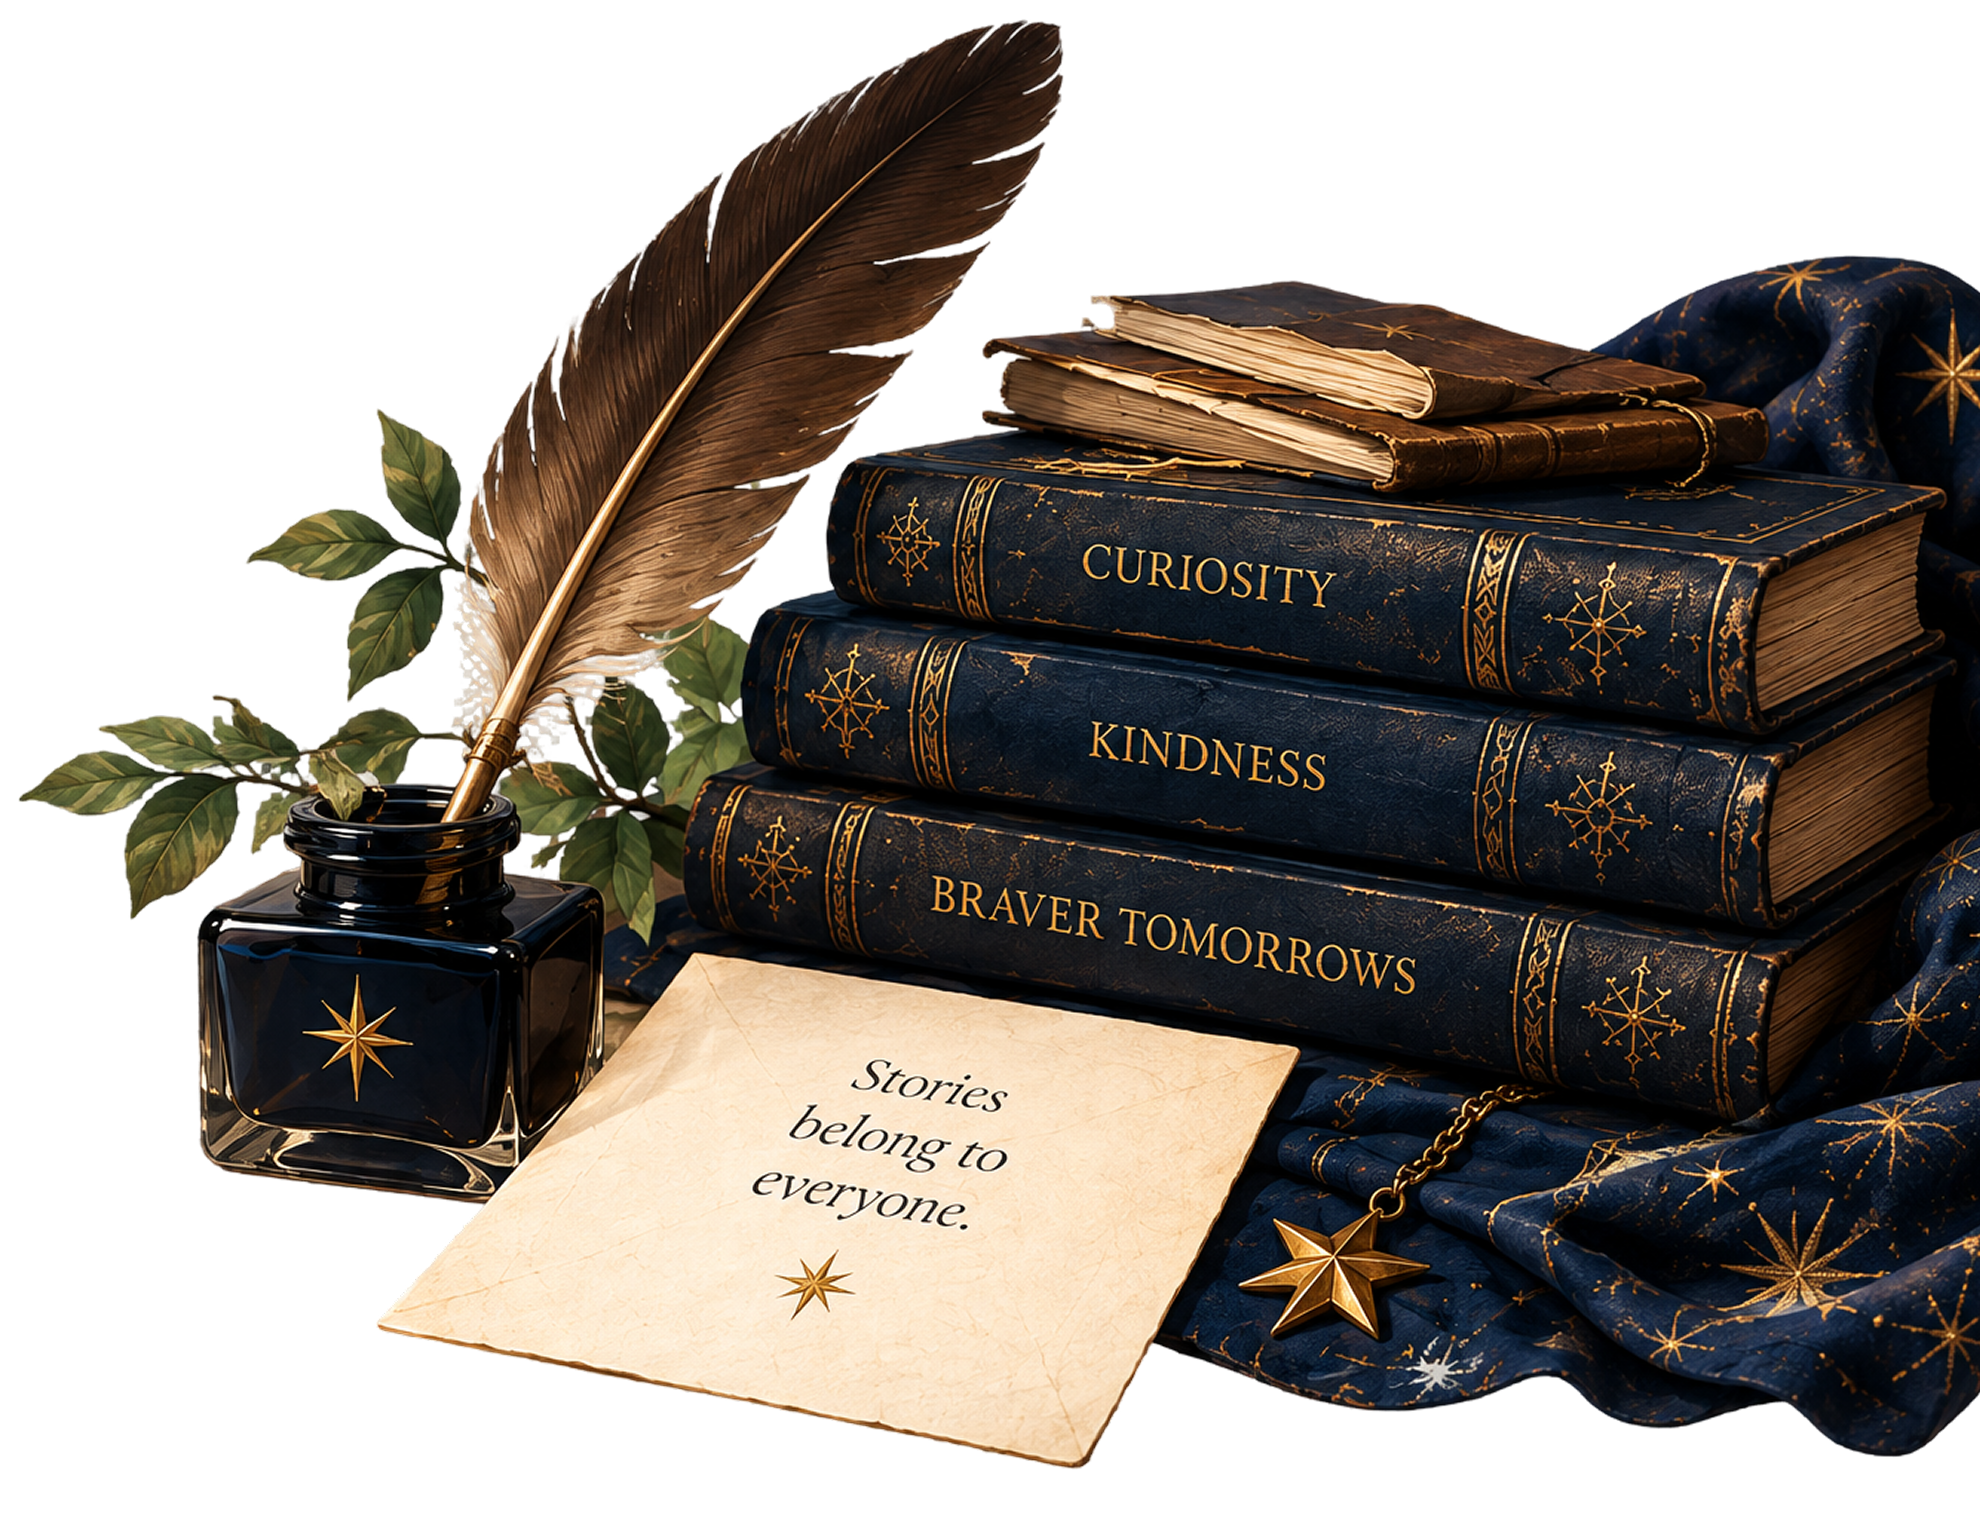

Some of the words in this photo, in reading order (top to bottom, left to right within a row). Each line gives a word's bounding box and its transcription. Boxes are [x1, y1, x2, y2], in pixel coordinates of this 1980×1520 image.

[1082, 543, 1337, 609] CURIOSITY
[1089, 721, 1327, 791] KINDNESS
[930, 875, 1105, 940] BRAVER
[1118, 907, 1417, 995] TOMORROWS
[851, 1059, 1009, 1113] Stories
[788, 1103, 952, 1173] belong
[957, 1141, 1008, 1172] to
[752, 1171, 968, 1230] everyone.
